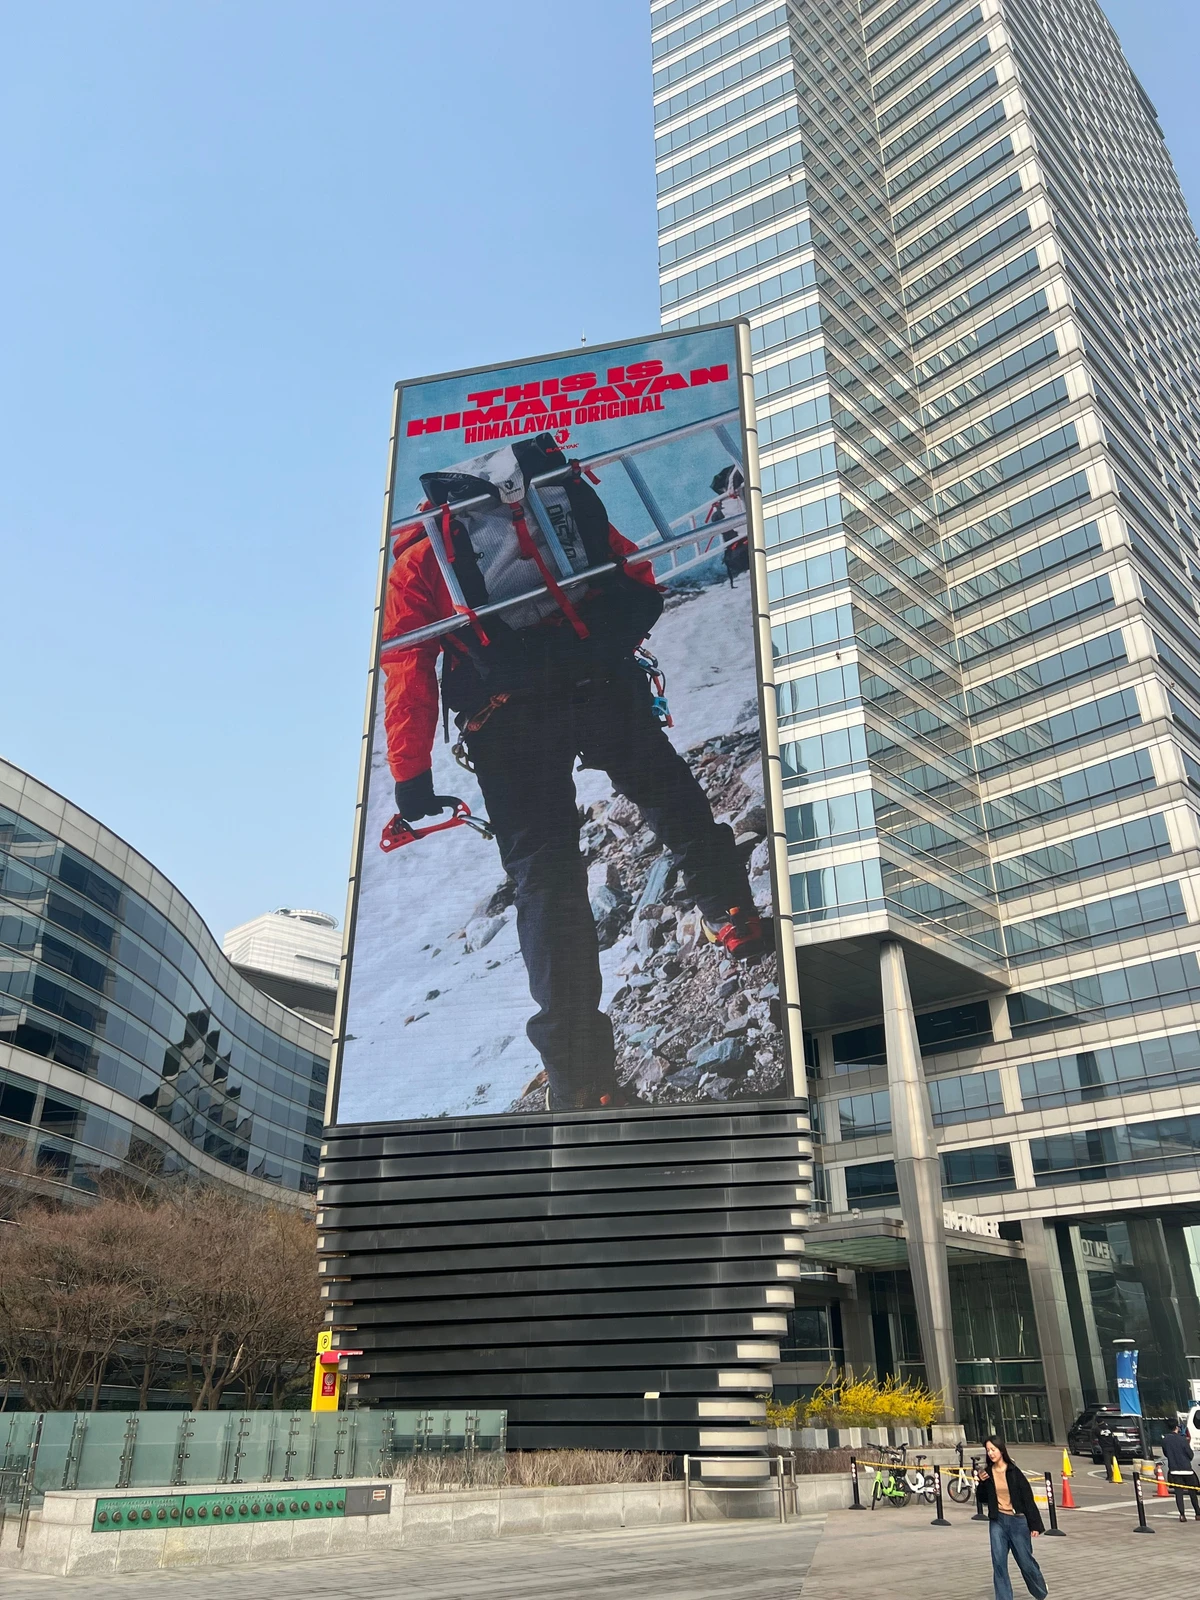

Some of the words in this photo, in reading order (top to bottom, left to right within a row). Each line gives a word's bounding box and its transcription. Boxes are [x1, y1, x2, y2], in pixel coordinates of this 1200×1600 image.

[406, 363, 729, 437] HIMALAYAN
[467, 371, 598, 408] THIS
[607, 359, 664, 385] IS
[464, 410, 572, 444] HIMALAYAN
[575, 393, 665, 425] ORIGINAL
